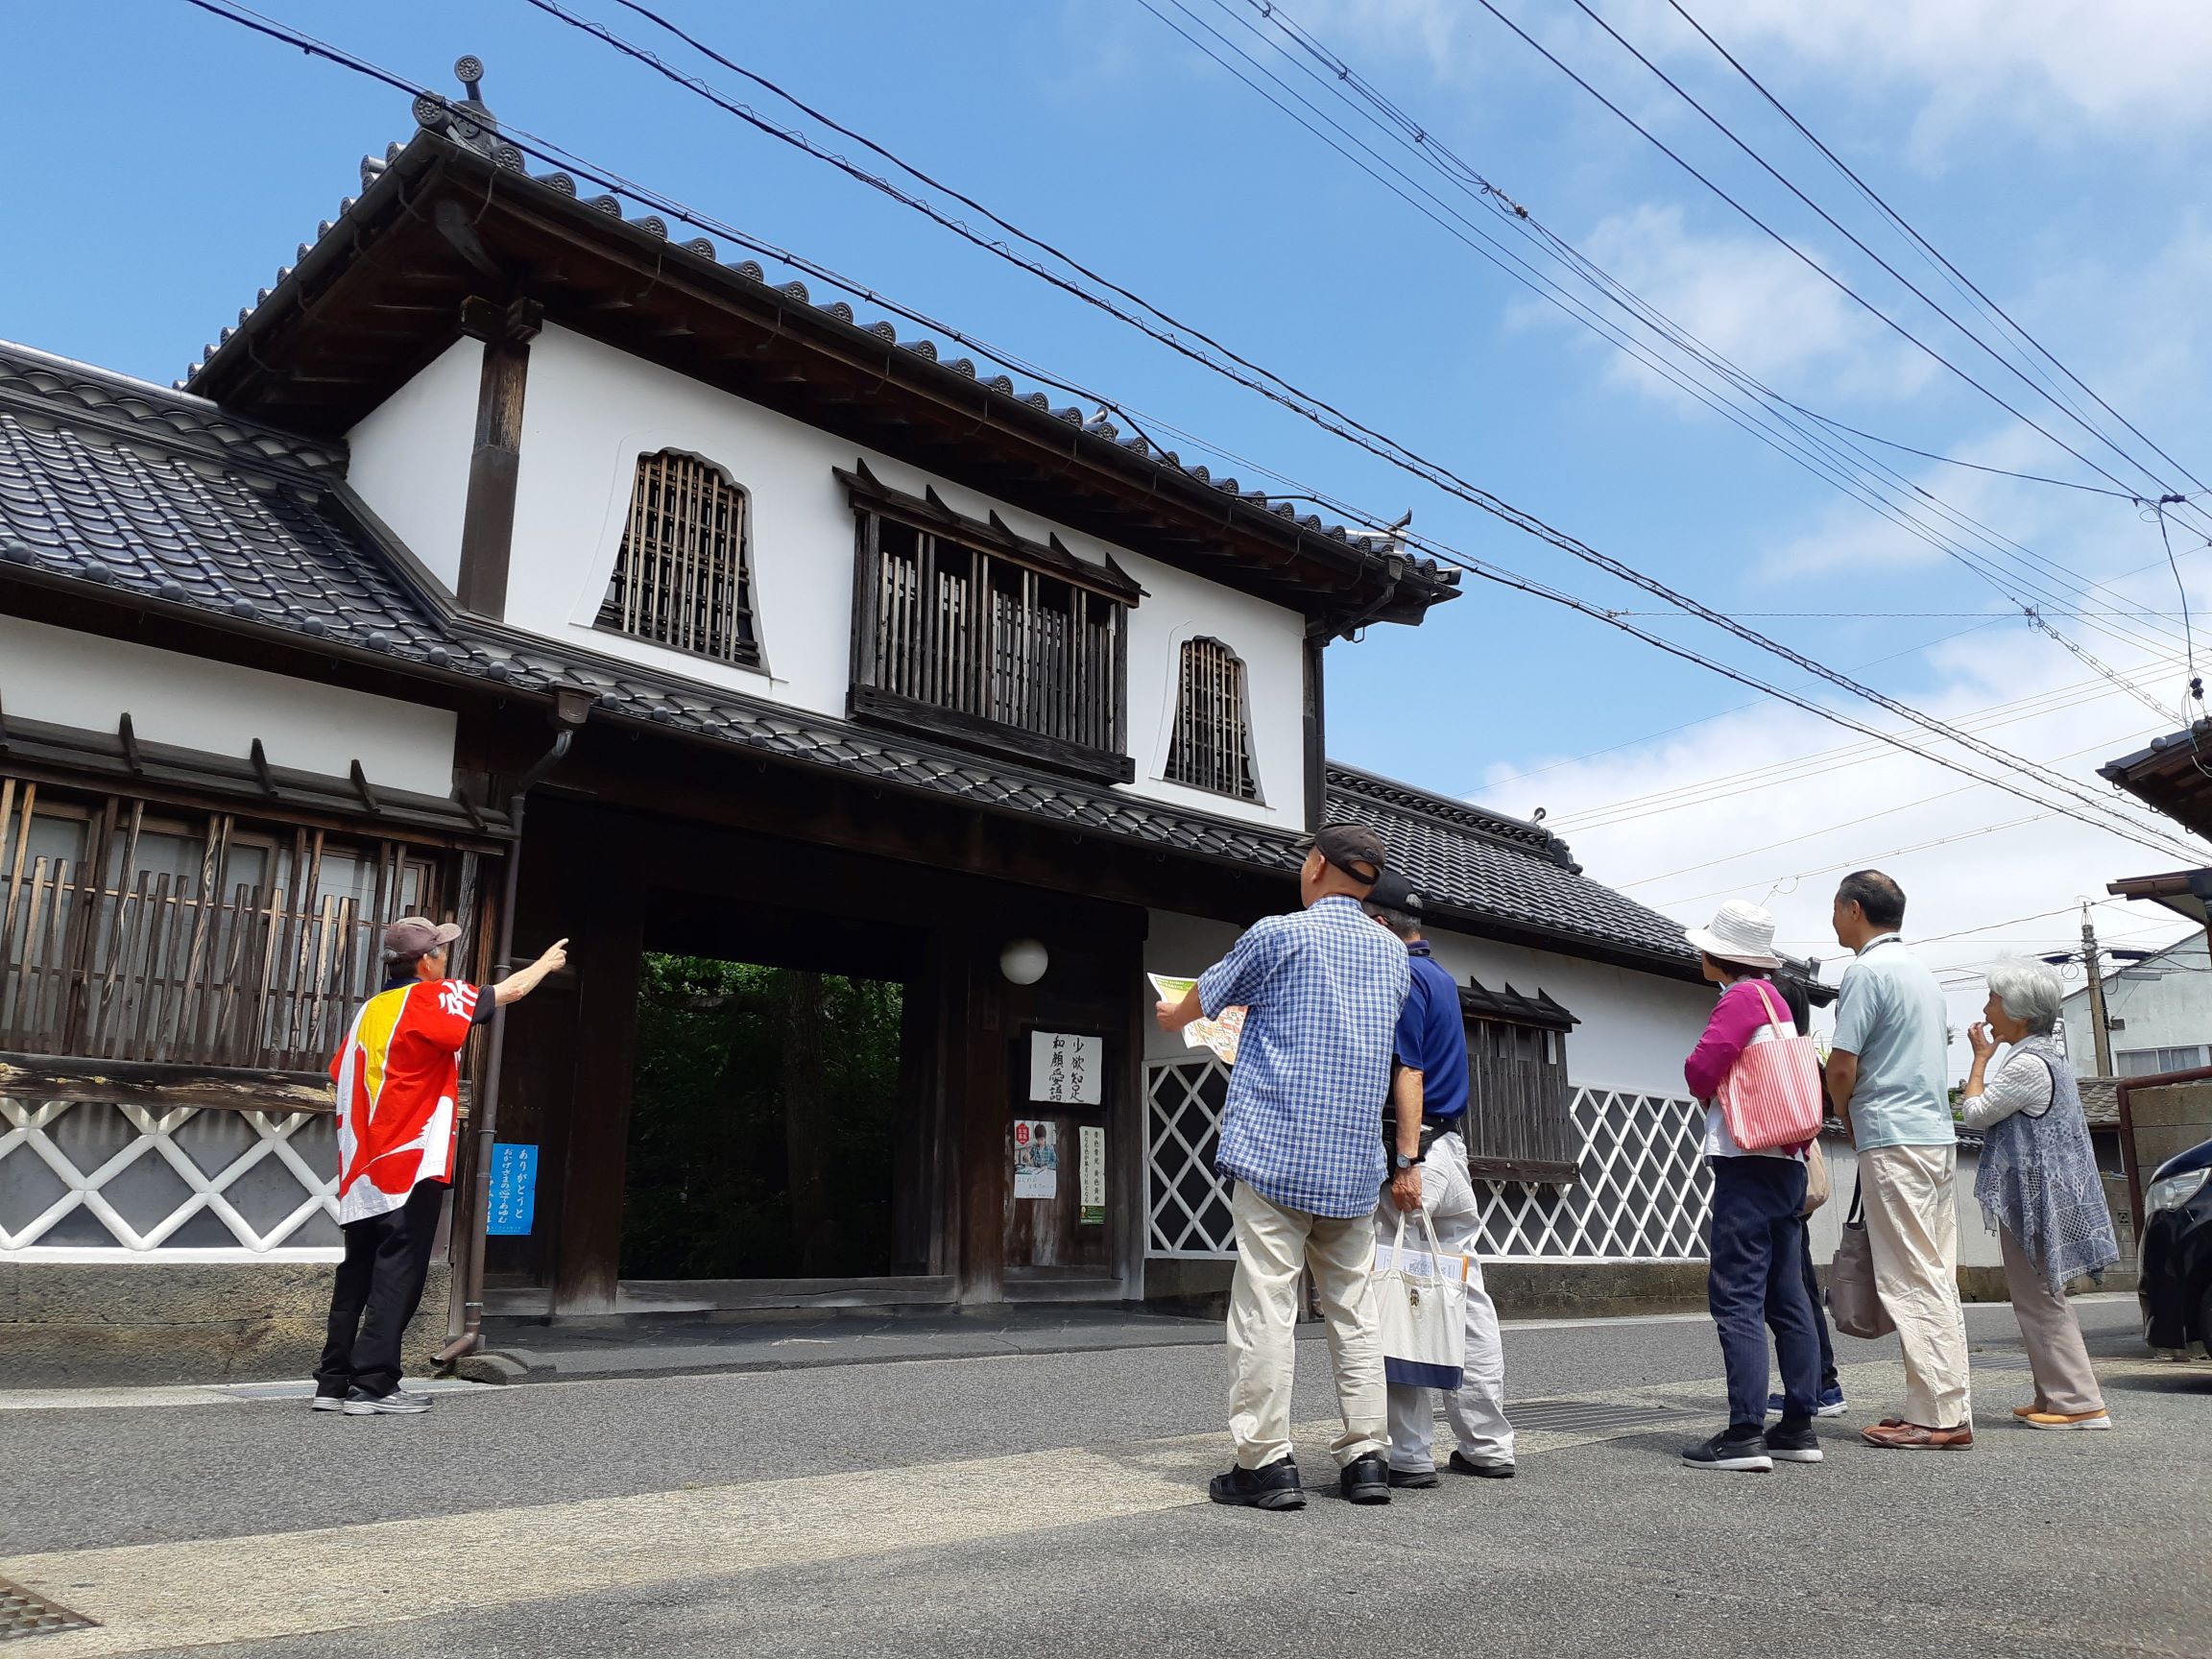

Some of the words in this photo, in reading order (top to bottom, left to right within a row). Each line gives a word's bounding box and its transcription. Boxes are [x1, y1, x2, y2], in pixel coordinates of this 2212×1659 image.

[1048, 1034, 1066, 1101] 和顔愛語
[1069, 1037, 1085, 1102] 少欲知足
[515, 1148, 528, 1219] ありがとうと
